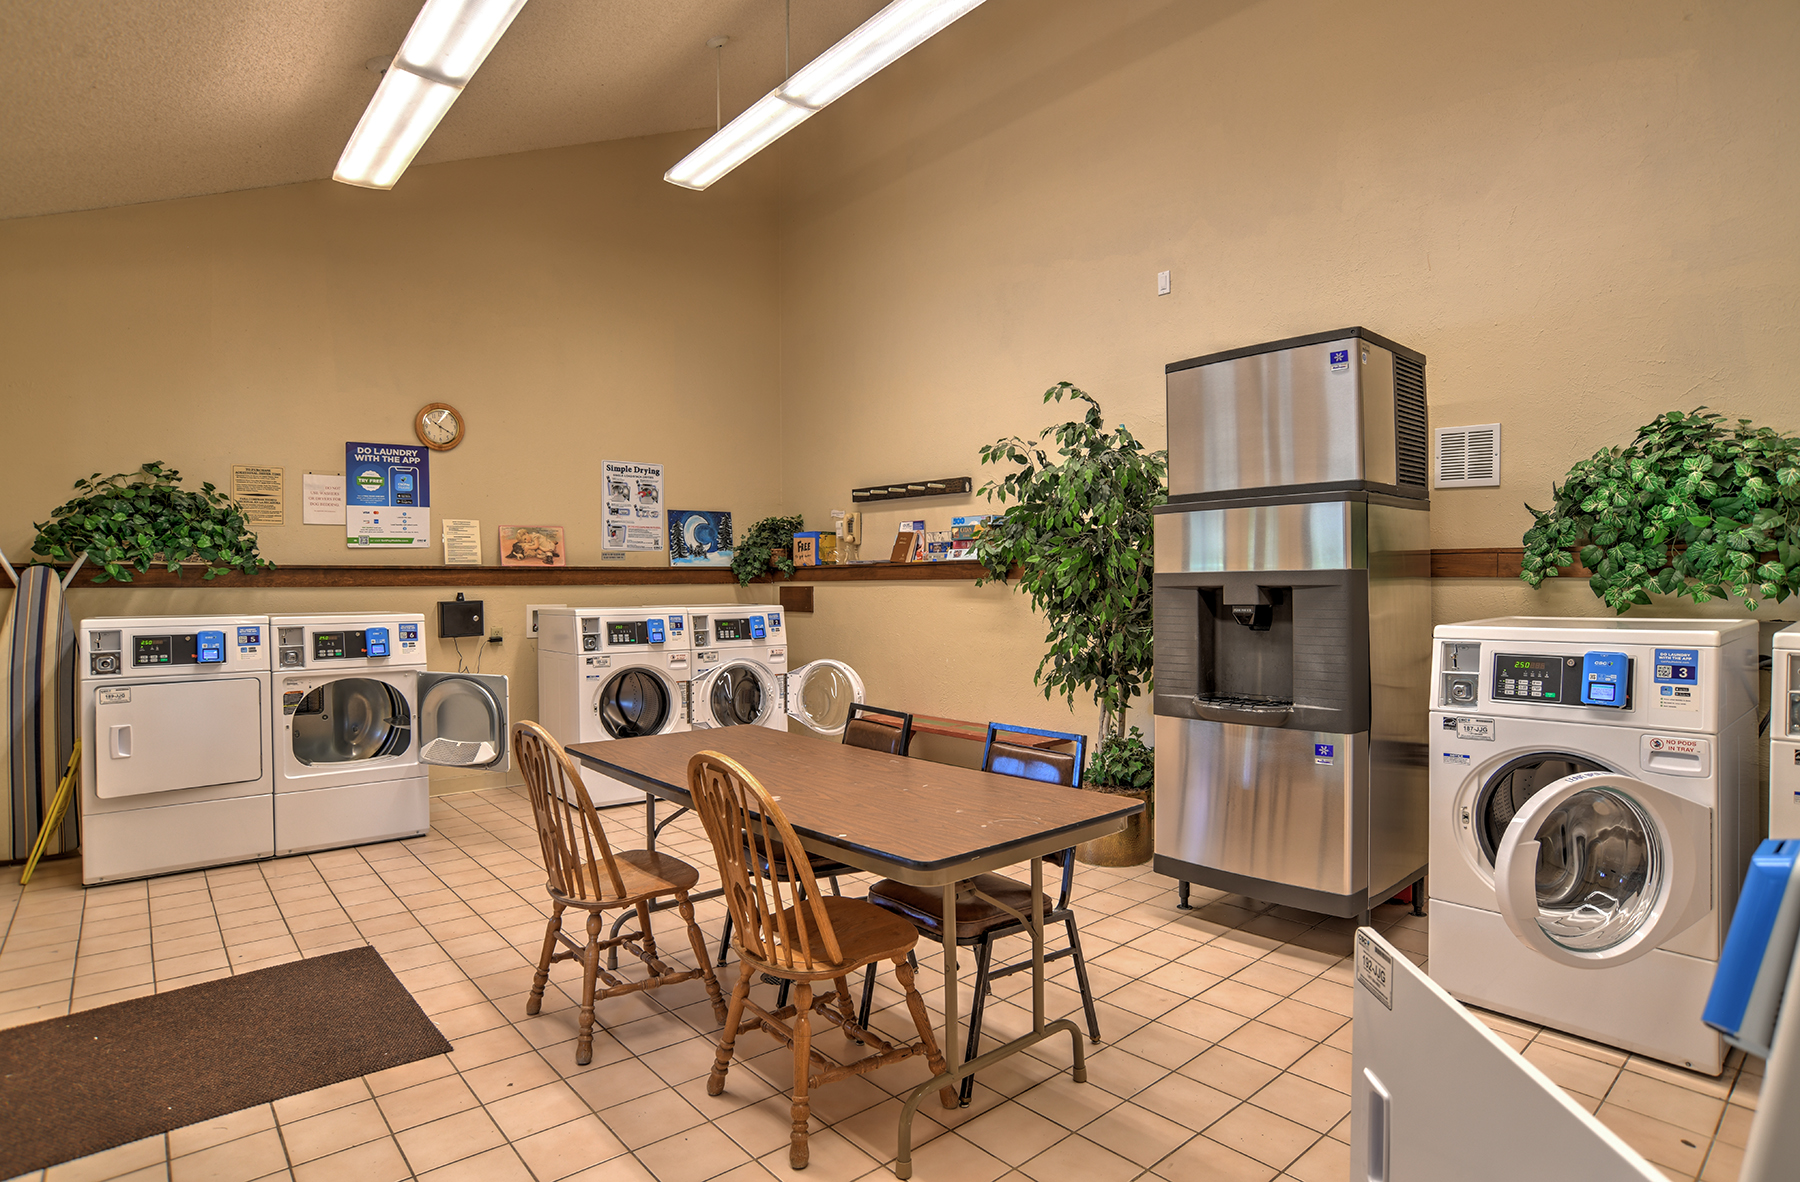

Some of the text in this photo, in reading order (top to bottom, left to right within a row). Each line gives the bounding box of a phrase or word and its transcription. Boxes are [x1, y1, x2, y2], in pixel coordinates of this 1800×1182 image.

[355, 454, 380, 462] WITH
[374, 448, 418, 457] LAUNDRY
[606, 464, 660, 476] Simple Drying
[798, 540, 811, 552] FREE
[1679, 667, 1688, 678] 3
[1362, 954, 1386, 983] 192-JJG
